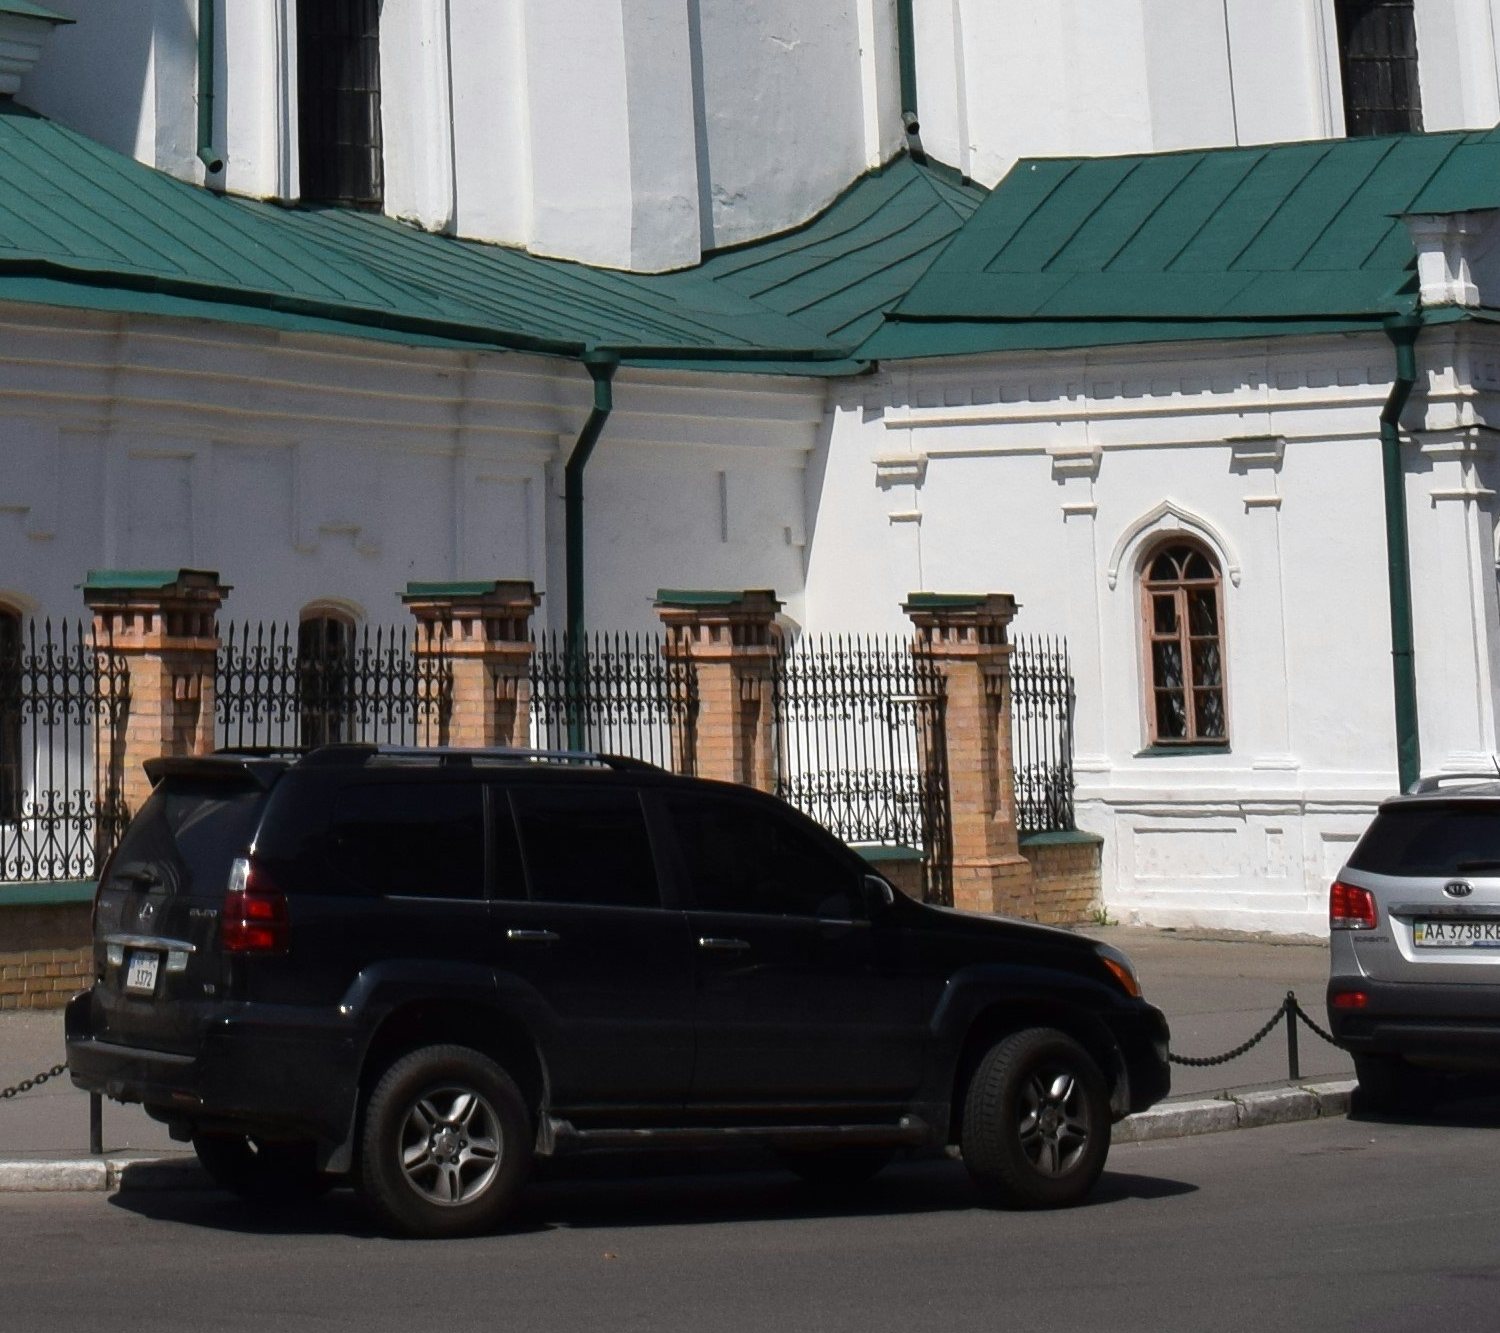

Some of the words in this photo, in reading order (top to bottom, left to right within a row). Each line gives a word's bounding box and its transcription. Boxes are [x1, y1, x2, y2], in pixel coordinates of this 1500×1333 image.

[1450, 885, 1468, 893] KIA
[1424, 923, 1445, 939] AA
[1449, 924, 1482, 940] 3738
